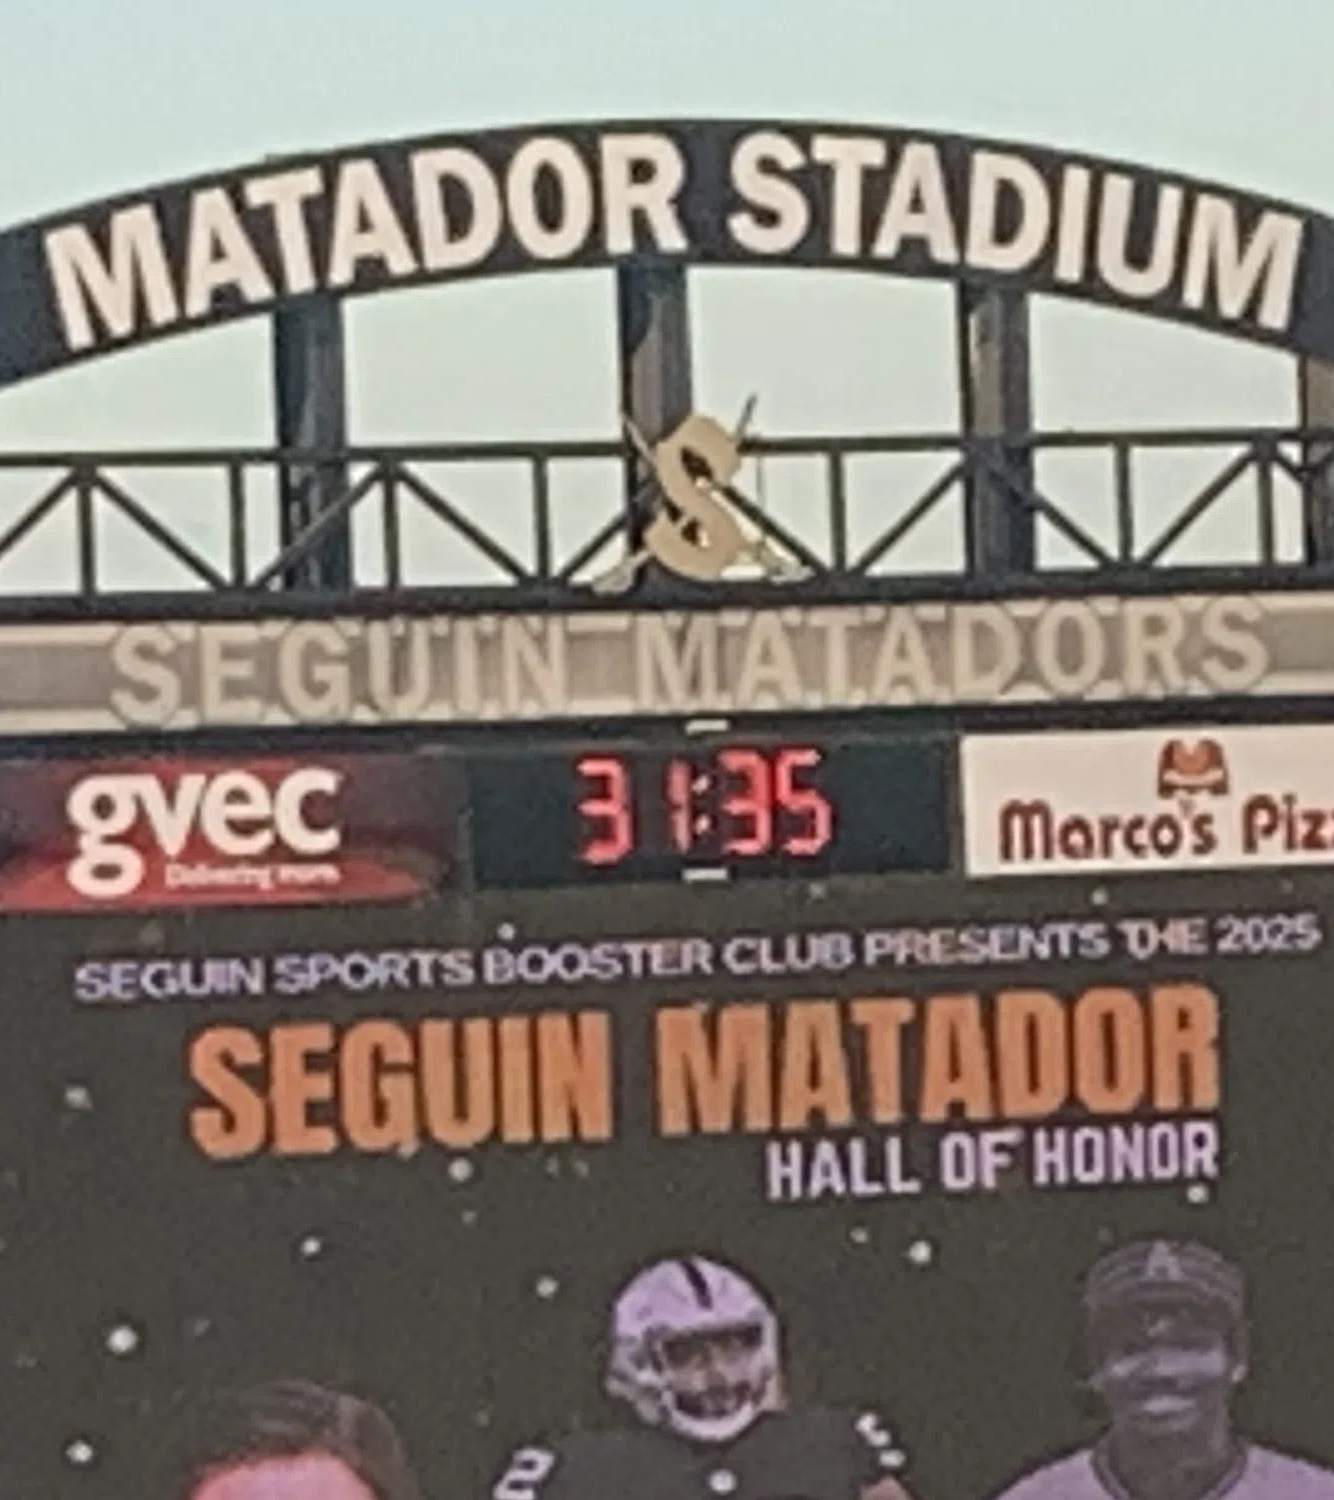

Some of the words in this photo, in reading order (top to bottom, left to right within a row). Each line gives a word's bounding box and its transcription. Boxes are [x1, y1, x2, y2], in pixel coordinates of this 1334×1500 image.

[43, 133, 688, 352] MATADOR
[727, 133, 1304, 334] STADIUM
[109, 618, 568, 728] SEGUIN
[635, 592, 1269, 714] MATADORS
[66, 766, 343, 897] gvec
[576, 750, 833, 866] 31:35
[998, 801, 1218, 862] Marco's
[75, 960, 264, 1002] SEGUIN
[274, 952, 475, 995] SPORTS
[482, 939, 712, 982] BOOSTER
[722, 934, 855, 975] CLUB
[865, 922, 1111, 966] PRESENTS
[1118, 917, 1208, 959] THE
[1217, 913, 1322, 951] 2025
[189, 1009, 614, 1161] SEGUIN
[655, 984, 1221, 1136] MATADOR
[767, 1137, 921, 1199] HALL
[940, 1129, 1024, 1190] OF
[1034, 1120, 1219, 1185] HONOR
